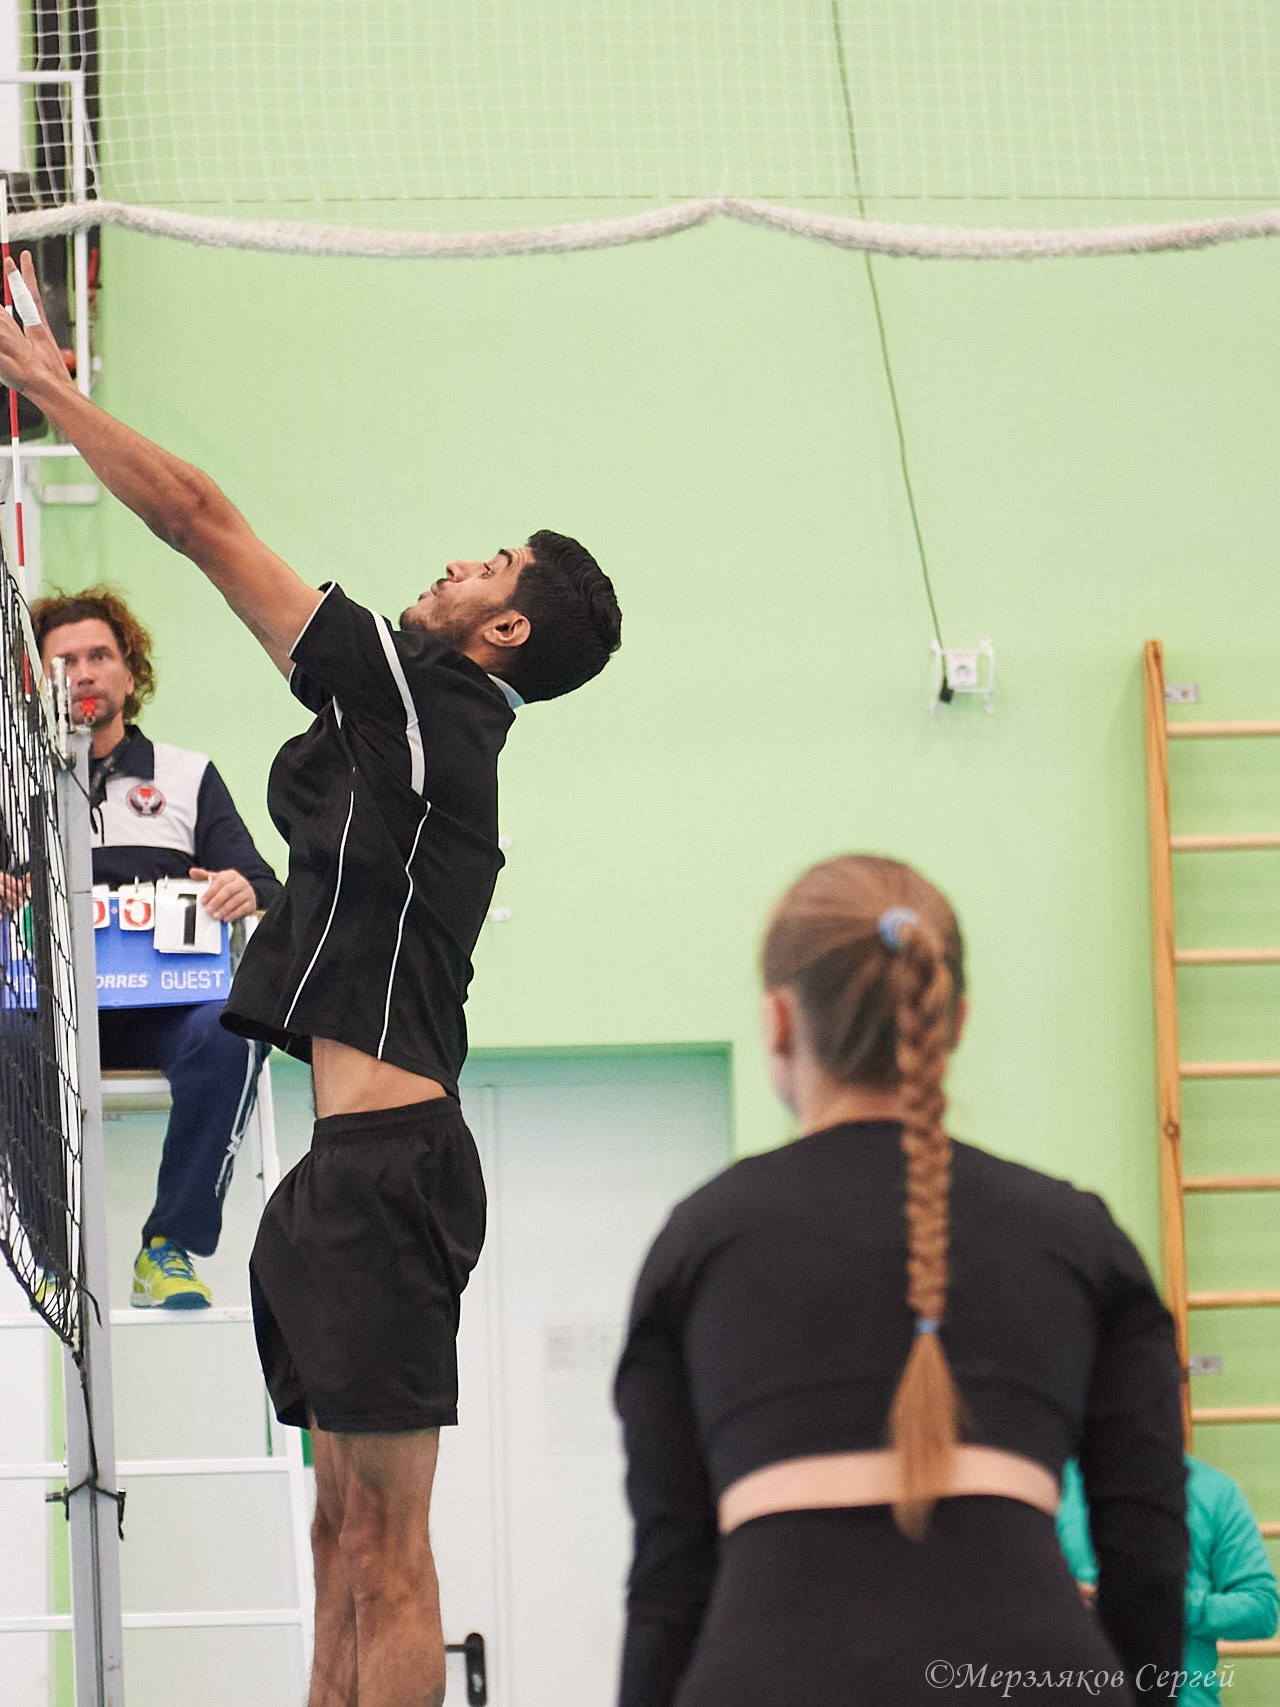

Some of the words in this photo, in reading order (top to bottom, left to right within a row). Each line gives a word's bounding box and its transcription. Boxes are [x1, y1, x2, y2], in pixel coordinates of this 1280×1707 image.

[177, 893, 197, 946] 1
[96, 974, 149, 989] ORRES
[161, 970, 225, 989] GUEST
